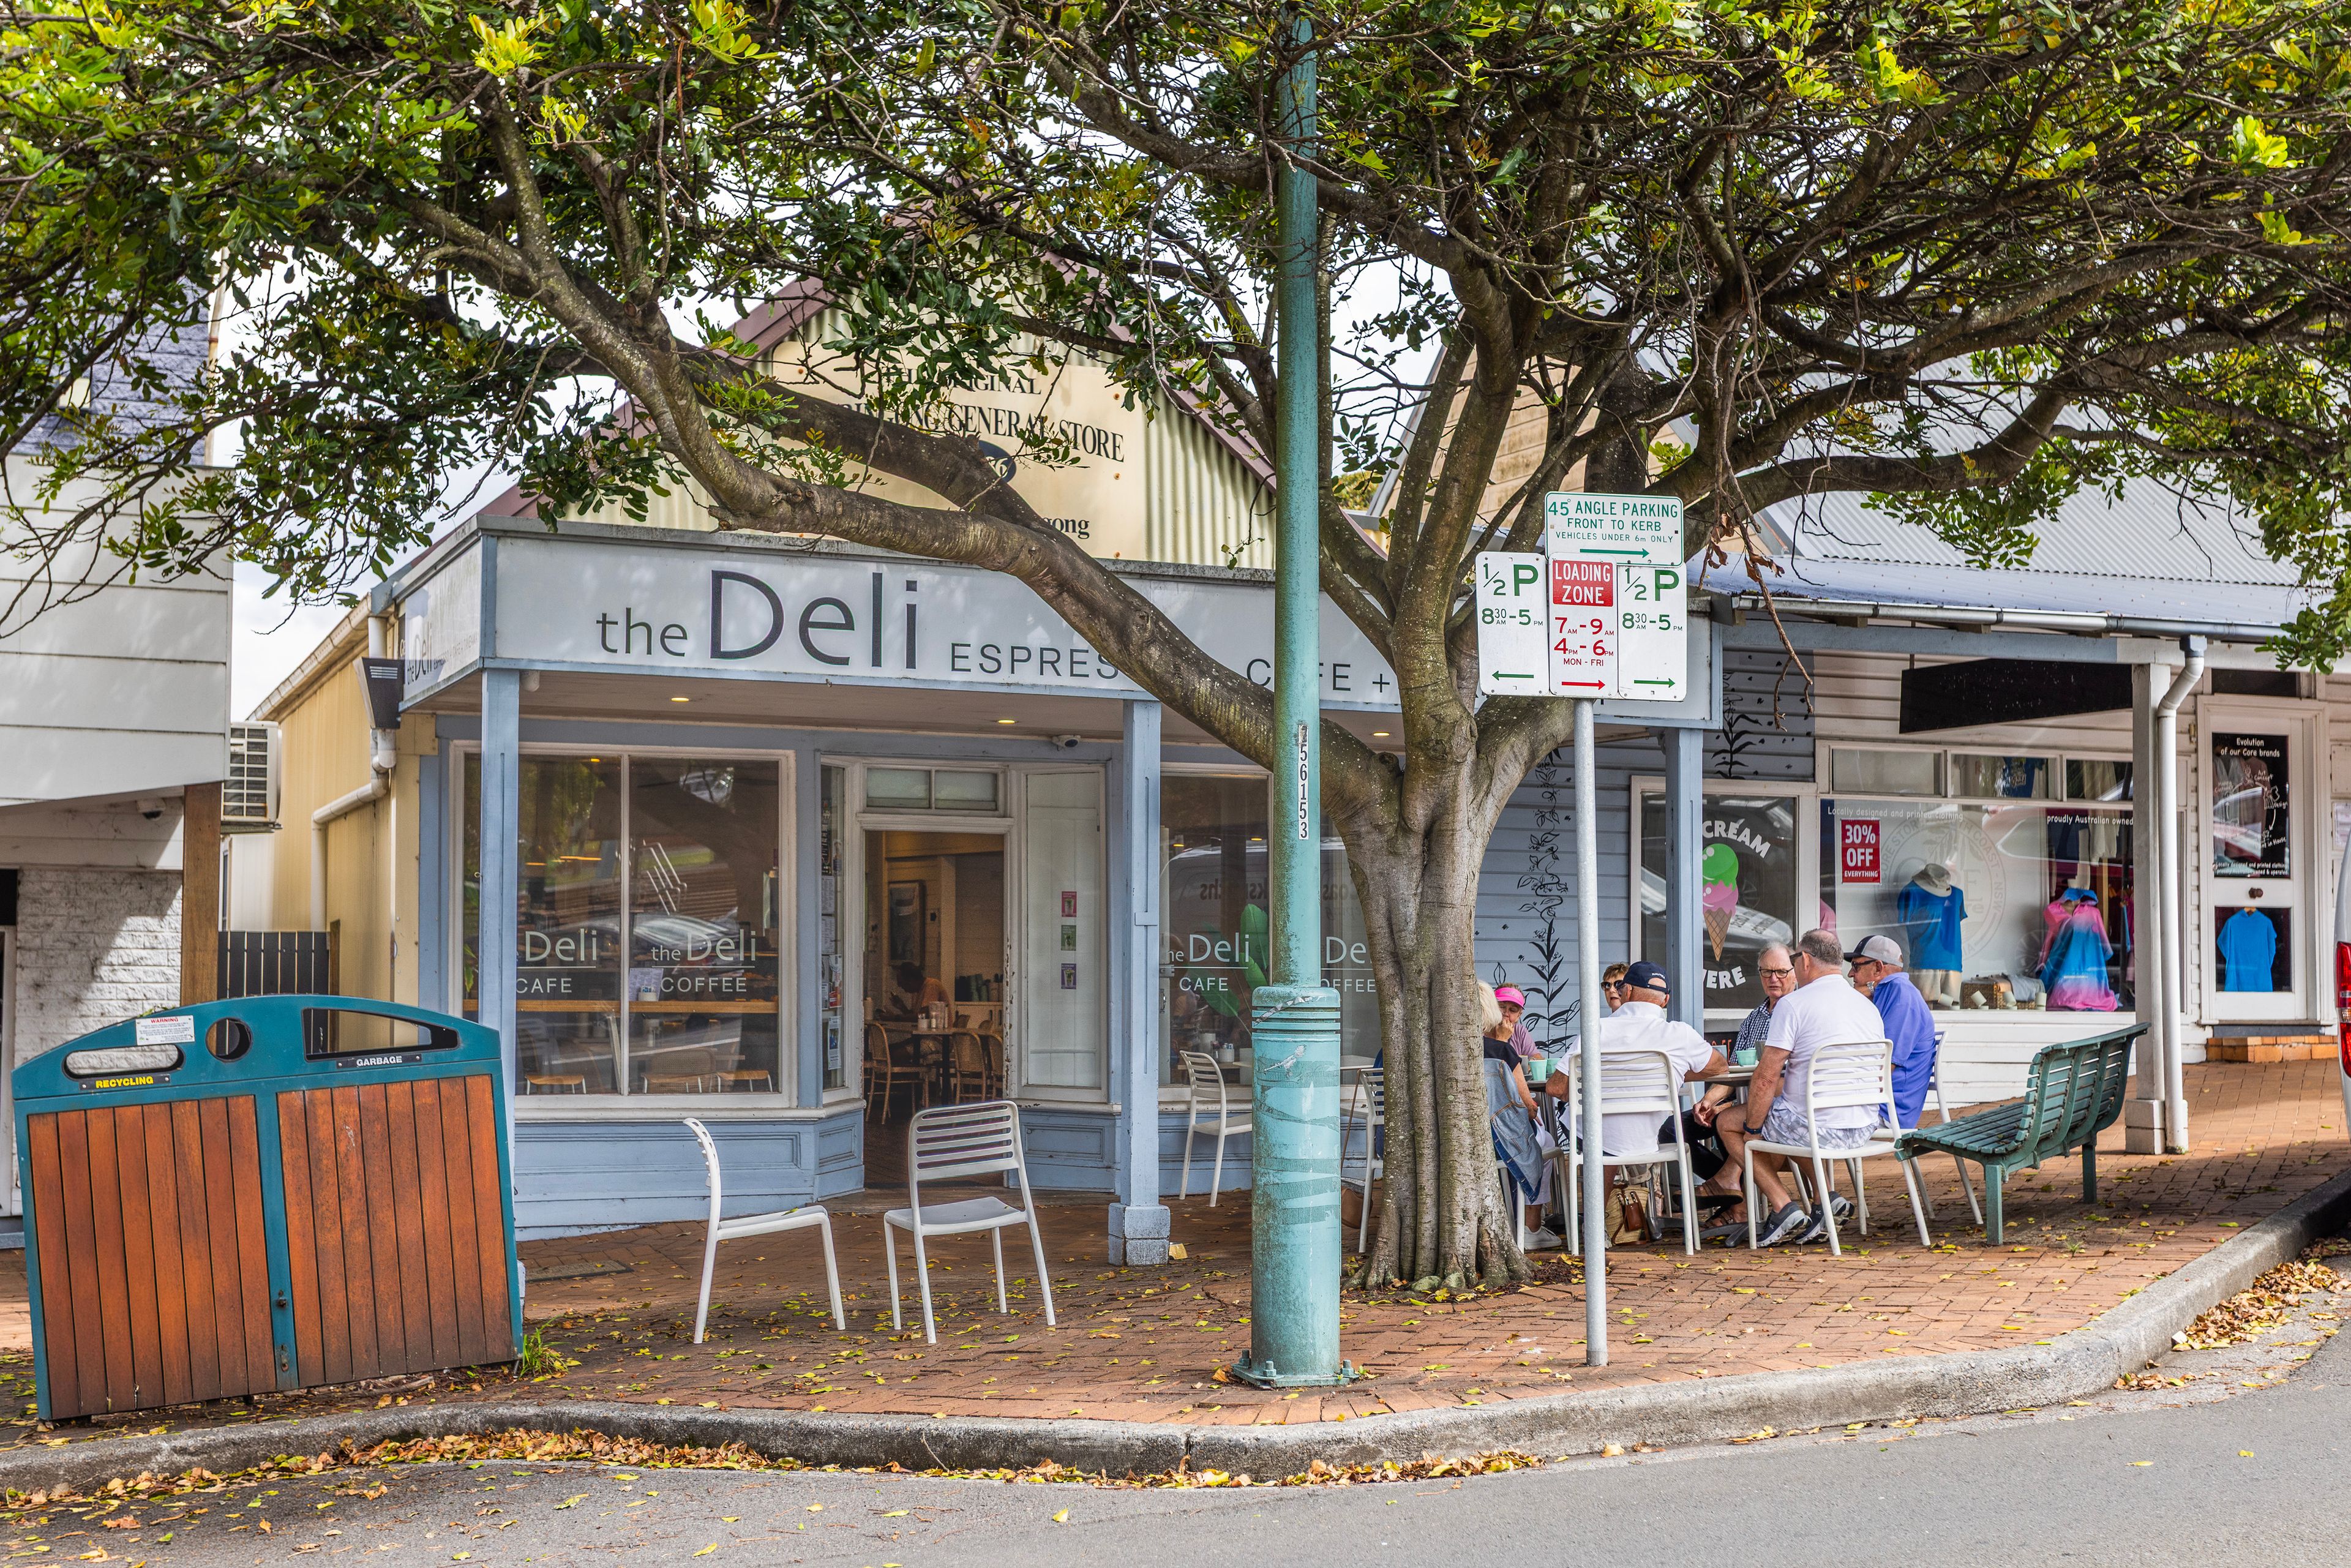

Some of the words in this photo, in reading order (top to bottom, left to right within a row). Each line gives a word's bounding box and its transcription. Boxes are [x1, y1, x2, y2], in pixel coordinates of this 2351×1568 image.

[1059, 419, 1125, 462] STORE
[1575, 501, 1617, 515] ANGLE
[1622, 503, 1678, 517] PARKING
[1567, 518, 1604, 529] FRONT
[1611, 520, 1624, 530] TO
[1632, 520, 1661, 531] KERB
[1556, 531, 1597, 540] VEHICLES
[1513, 564, 1539, 596] P
[1555, 563, 1611, 582] LOADING
[1655, 569, 1679, 601] P
[1562, 585, 1604, 604] ZONE
[596, 607, 688, 657] the
[710, 569, 918, 669] Deli
[951, 643, 1119, 680] ESPRES
[2237, 738, 2264, 746] Evolution
[2221, 747, 2228, 756] of
[2259, 748, 2280, 757] brands
[1828, 806, 1853, 817] Locally
[1856, 807, 1888, 819] designed
[1891, 809, 1903, 818] and
[1907, 809, 1932, 820] printed
[1935, 811, 1963, 822] clothing
[2047, 814, 2072, 825] proudly
[2075, 815, 2109, 824] Australian
[2112, 817, 2134, 825] owned
[1703, 820, 1771, 858] CREAM
[1845, 825, 1876, 844] 30%
[1847, 848, 1873, 867] OFF
[525, 928, 596, 962] Deli
[651, 945, 681, 961] the
[688, 929, 756, 961] Deli
[1189, 932, 1250, 962] Deli
[516, 978, 572, 993] CAFE
[661, 977, 747, 992] COFFEE
[1179, 977, 1228, 991] CAFE
[356, 1056, 402, 1067] GARBAGE
[96, 1076, 153, 1089] RECYCLING
